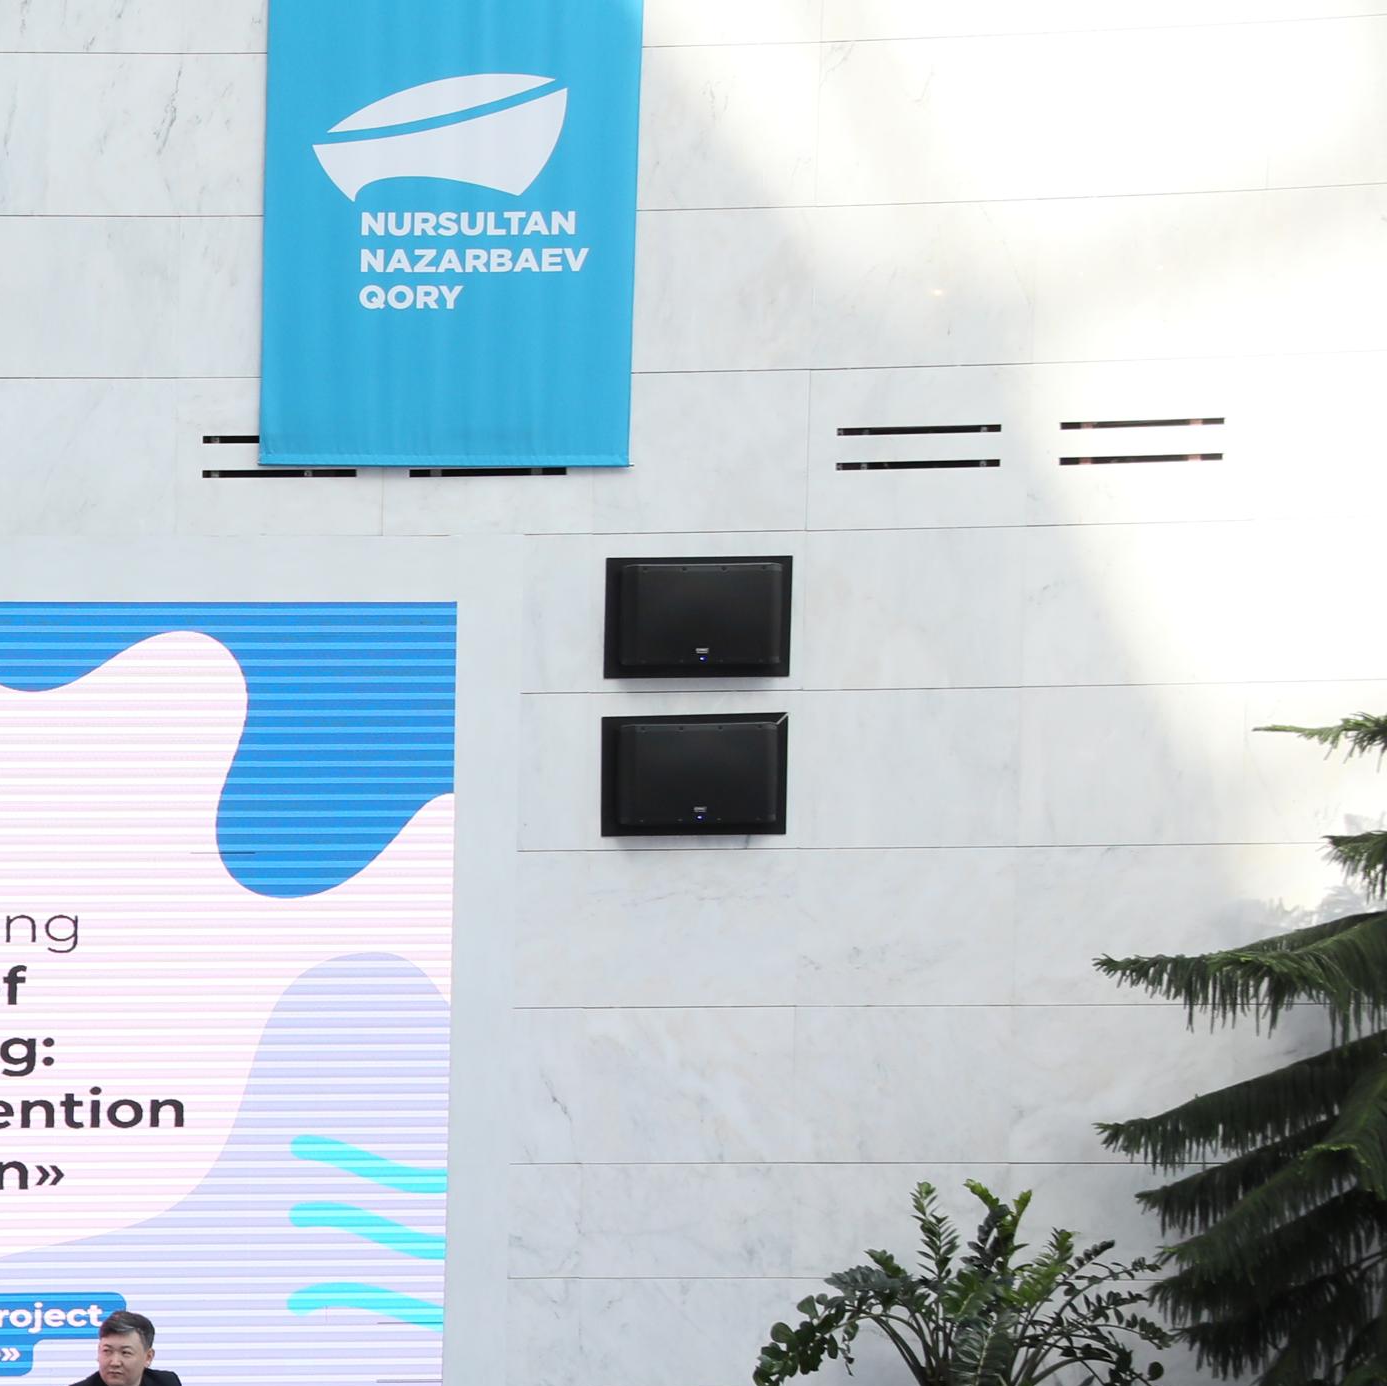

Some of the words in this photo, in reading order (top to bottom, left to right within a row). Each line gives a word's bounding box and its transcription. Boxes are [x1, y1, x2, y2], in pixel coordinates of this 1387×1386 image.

[360, 210, 576, 236] NURSULTAN
[360, 248, 590, 273] NAZARBAEV
[359, 284, 463, 310] QORY
